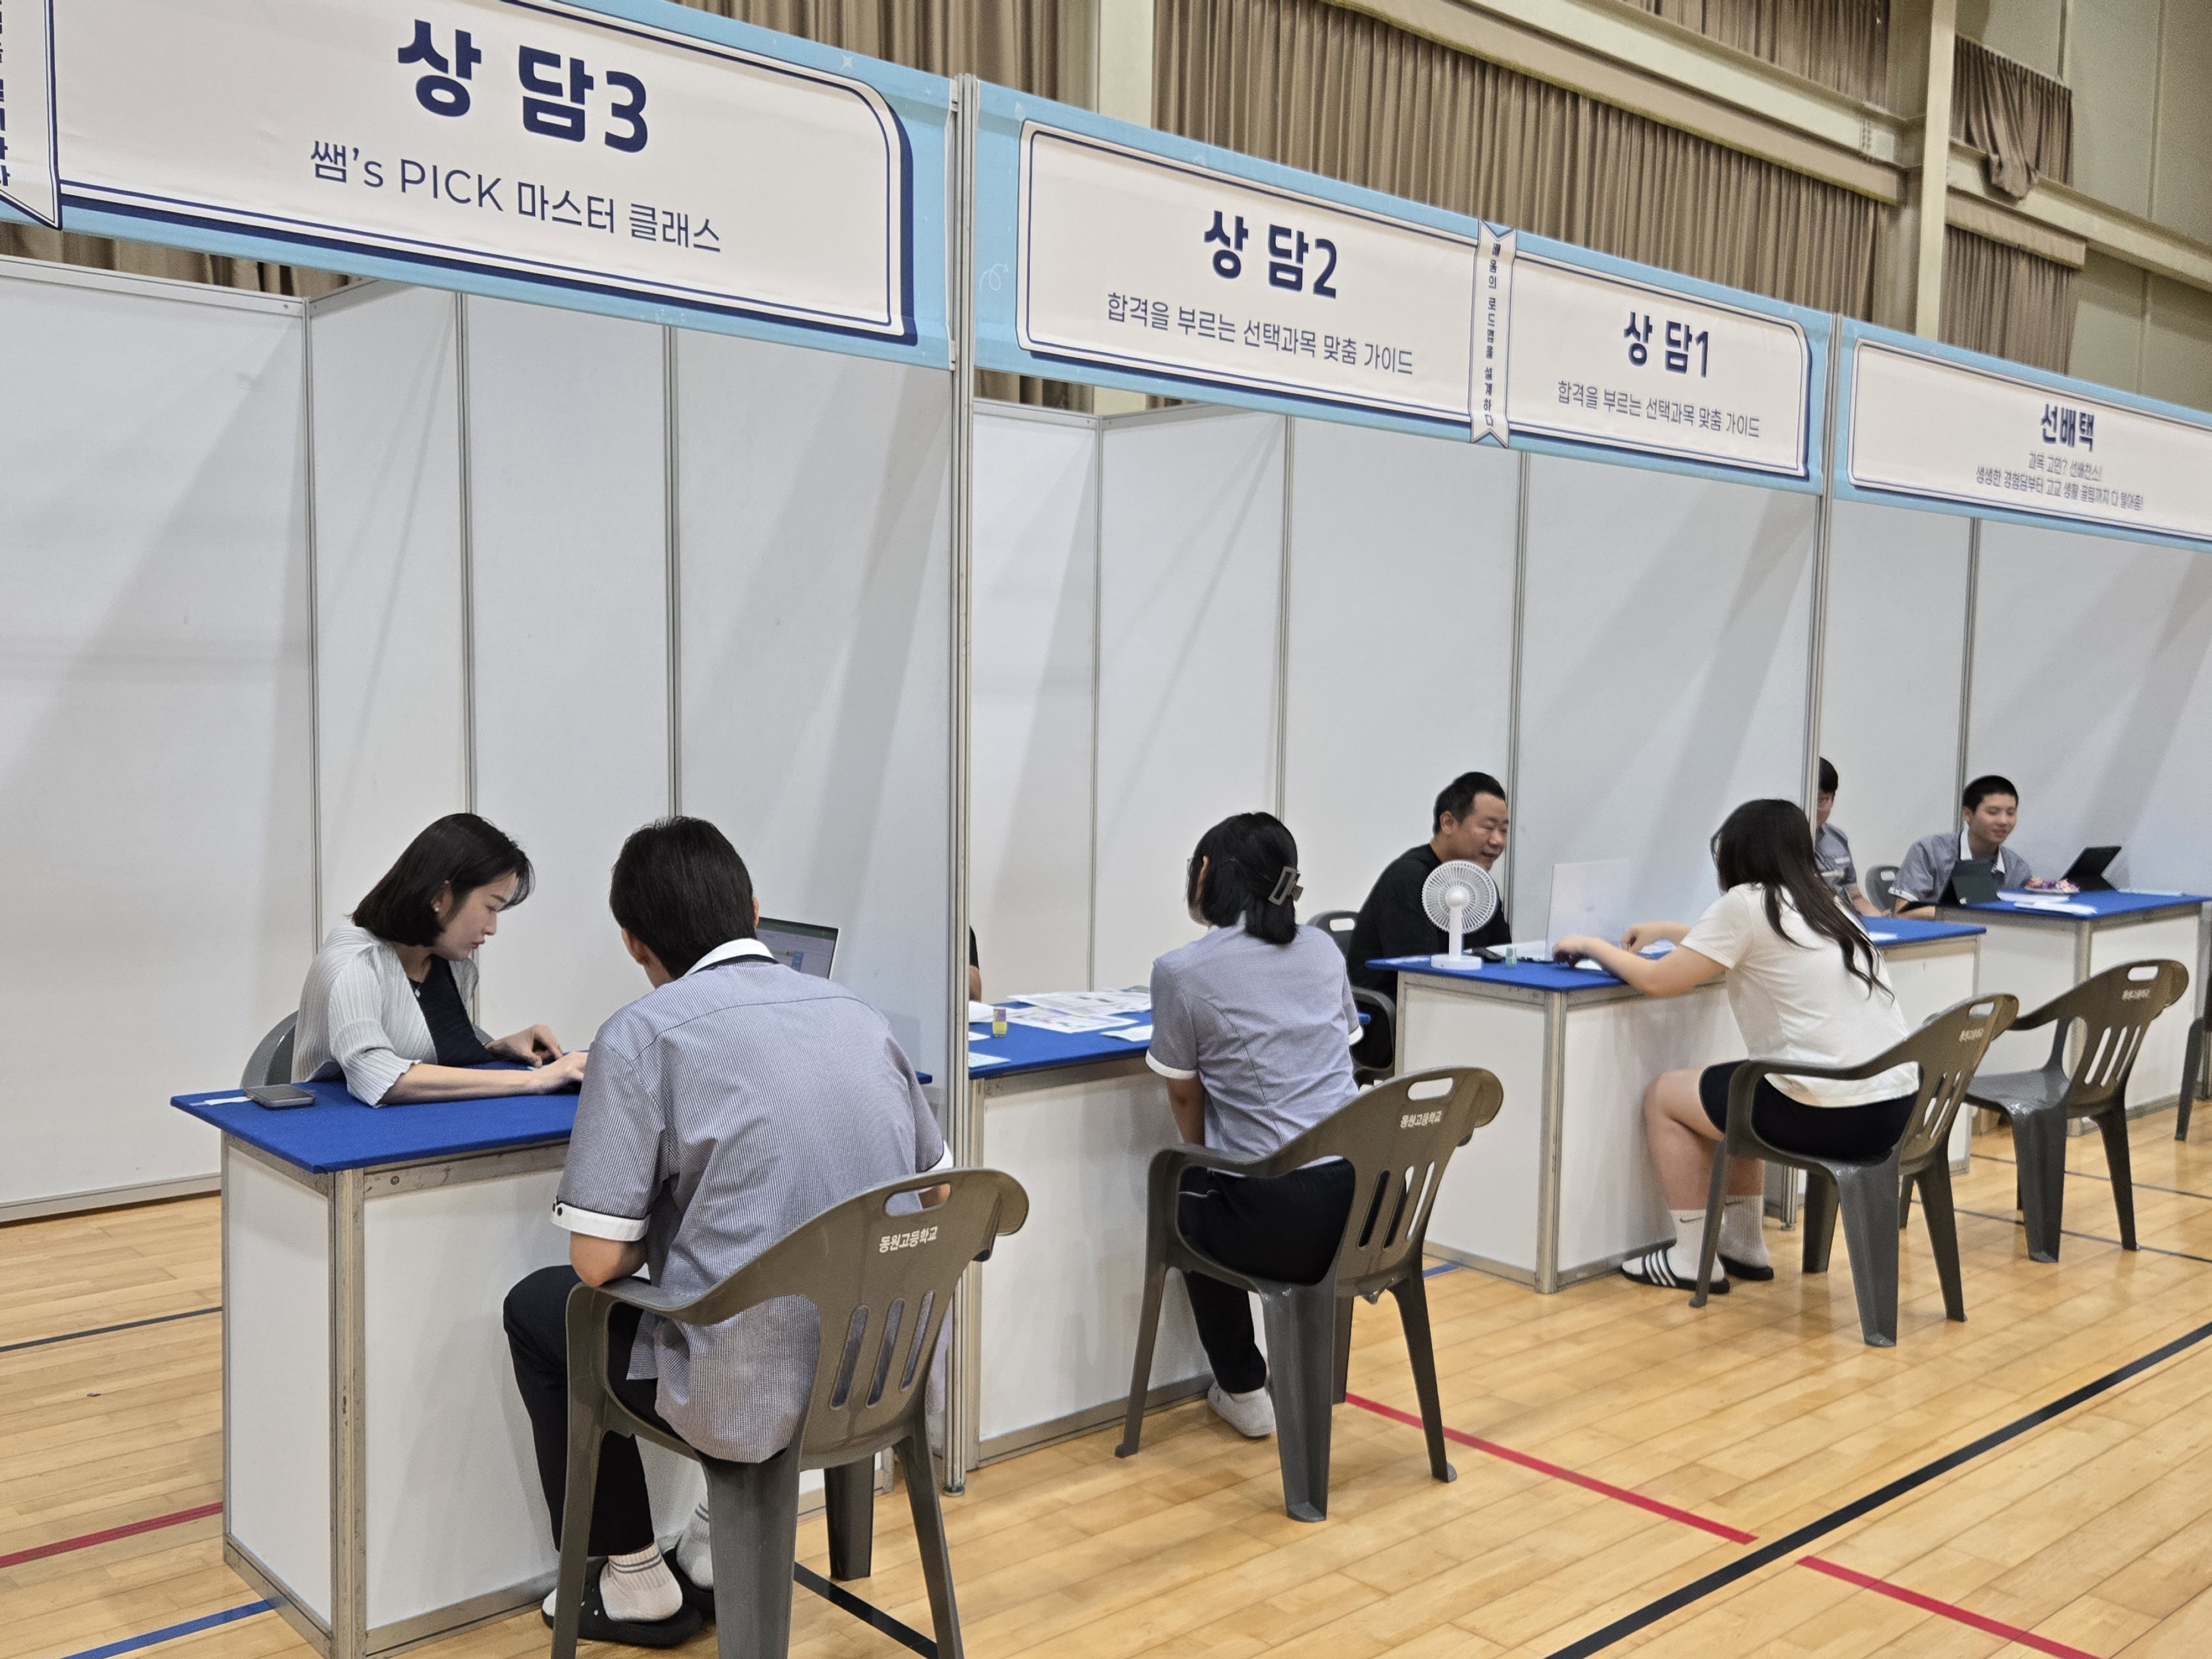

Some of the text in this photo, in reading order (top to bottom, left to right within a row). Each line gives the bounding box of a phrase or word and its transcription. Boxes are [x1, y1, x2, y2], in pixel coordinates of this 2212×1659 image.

[398, 19, 648, 153] 상 담3
[311, 140, 720, 252] 쌤's PICK 마스터 클래스
[1204, 211, 1337, 299] 상 담2
[1108, 293, 1412, 374] 합격을 부르는 선택과목 맞춤 가이드
[1624, 312, 1708, 378] 상 담1
[1483, 367, 1494, 427] 설계하다
[1558, 380, 1759, 437] 합격을 부르는 선택과목 맞춤 가이드
[2041, 403, 2094, 453] 선배택
[2046, 479, 2061, 497] 고교
[2111, 491, 2118, 507] 다
[1400, 1110, 1442, 1128] 동원고등학교
[879, 1226, 938, 1253] 동원고등학교
